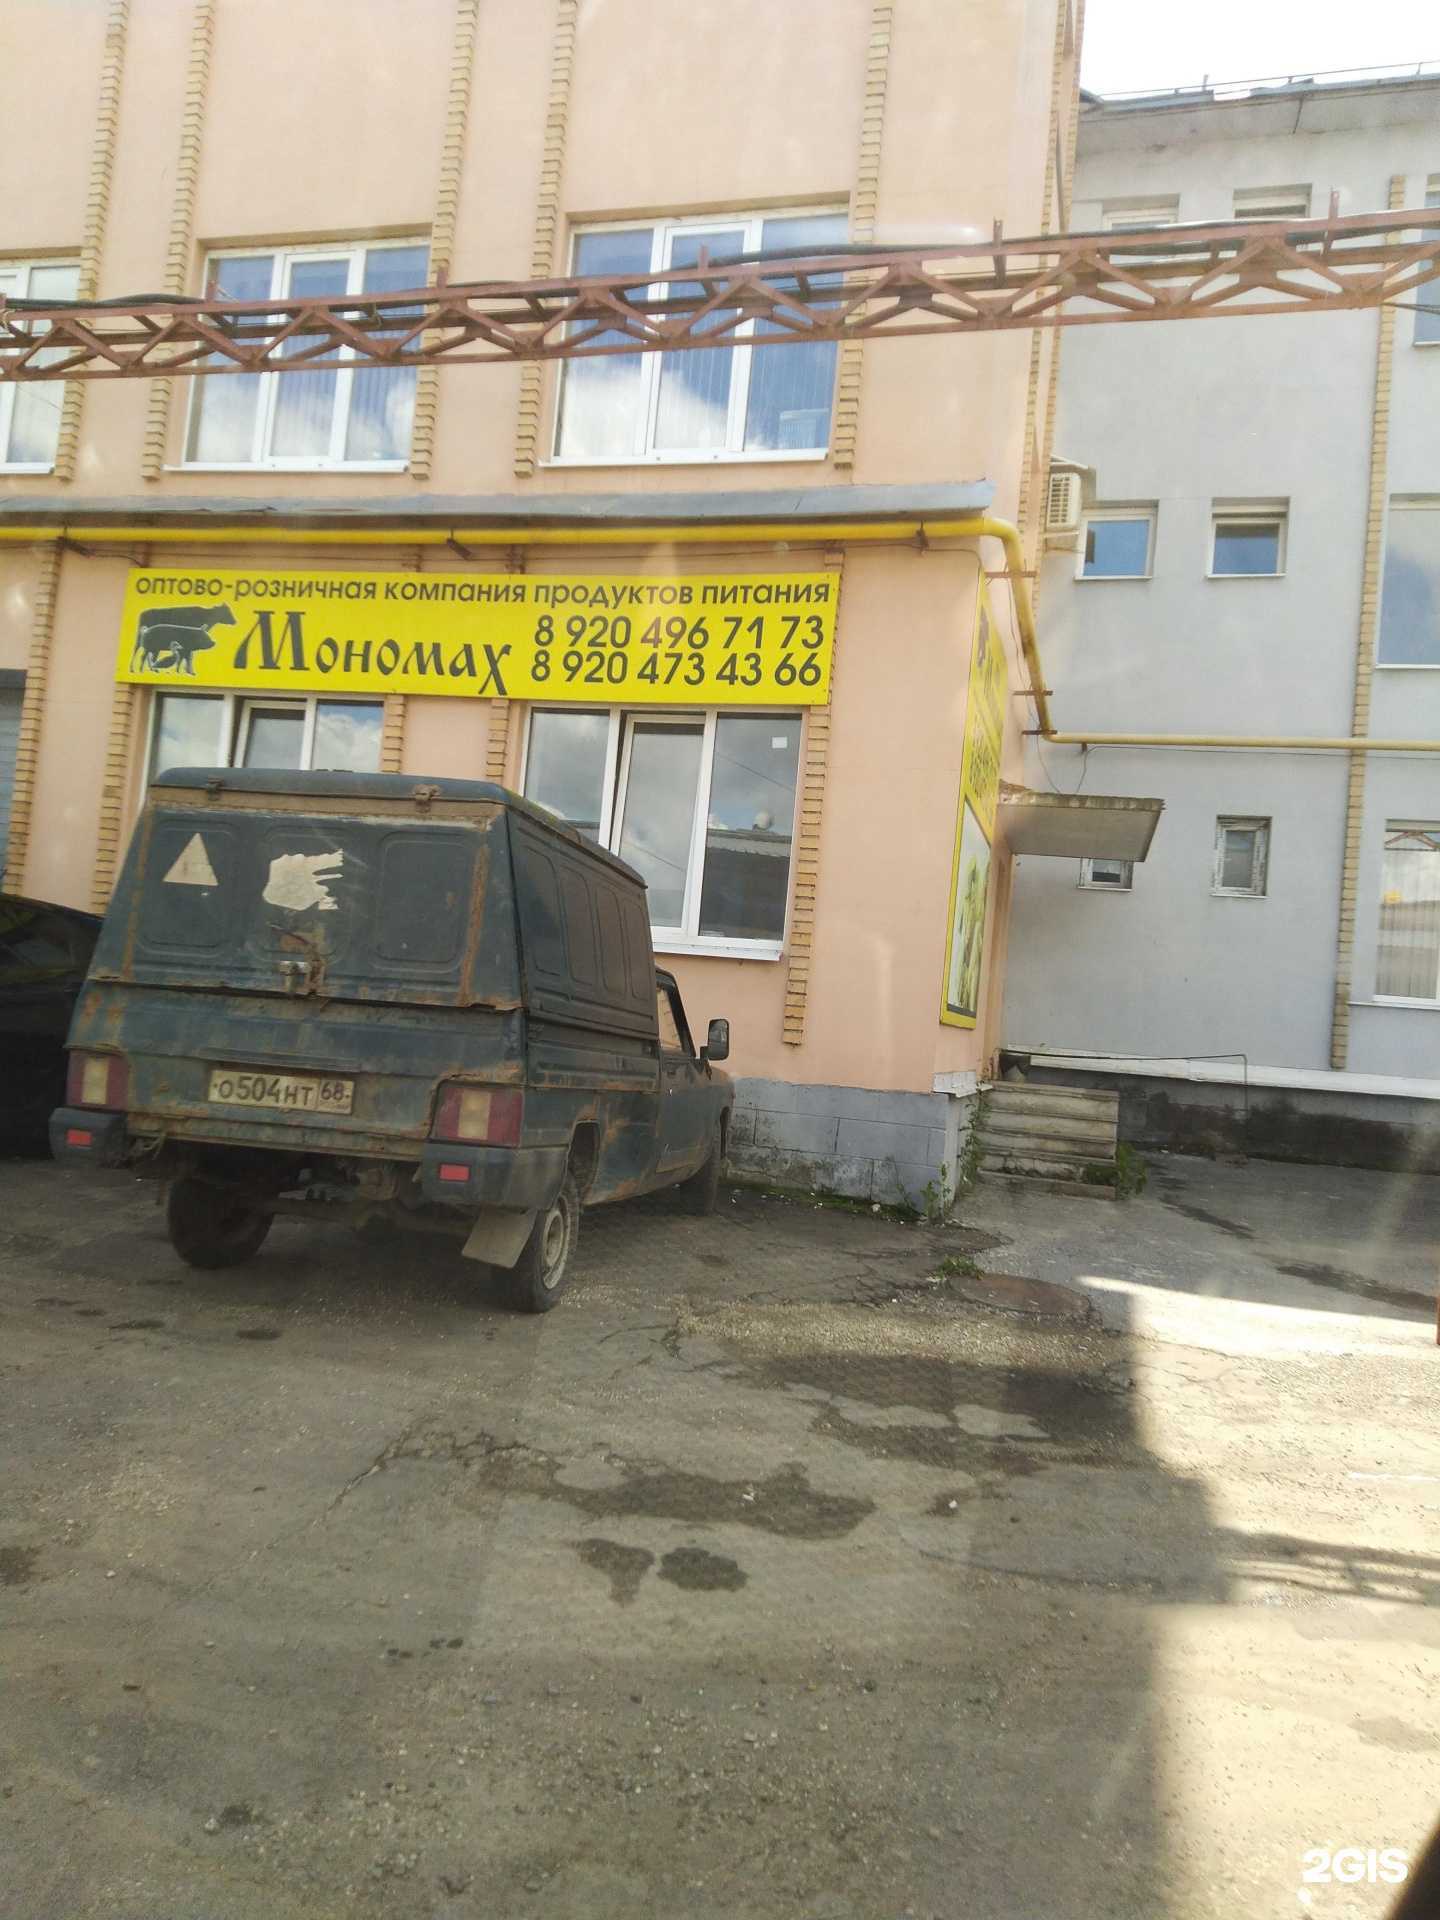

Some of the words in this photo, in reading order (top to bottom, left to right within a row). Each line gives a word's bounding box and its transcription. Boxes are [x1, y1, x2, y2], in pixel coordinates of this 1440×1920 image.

[136, 577, 376, 601] оптово-розничная
[384, 581, 526, 603] компания
[533, 584, 694, 609] продуктов
[701, 584, 830, 604] питания
[534, 615, 555, 646] 8
[566, 615, 632, 648] 920
[640, 616, 709, 649] 496
[723, 616, 765, 649] 71
[780, 616, 825, 649] 73
[233, 610, 512, 696] Мономах
[531, 650, 551, 681] 8
[562, 651, 629, 684] 920
[637, 653, 706, 685] 473
[716, 653, 763, 686] 43
[774, 653, 822, 687] 66
[321, 1080, 345, 1102] 68
